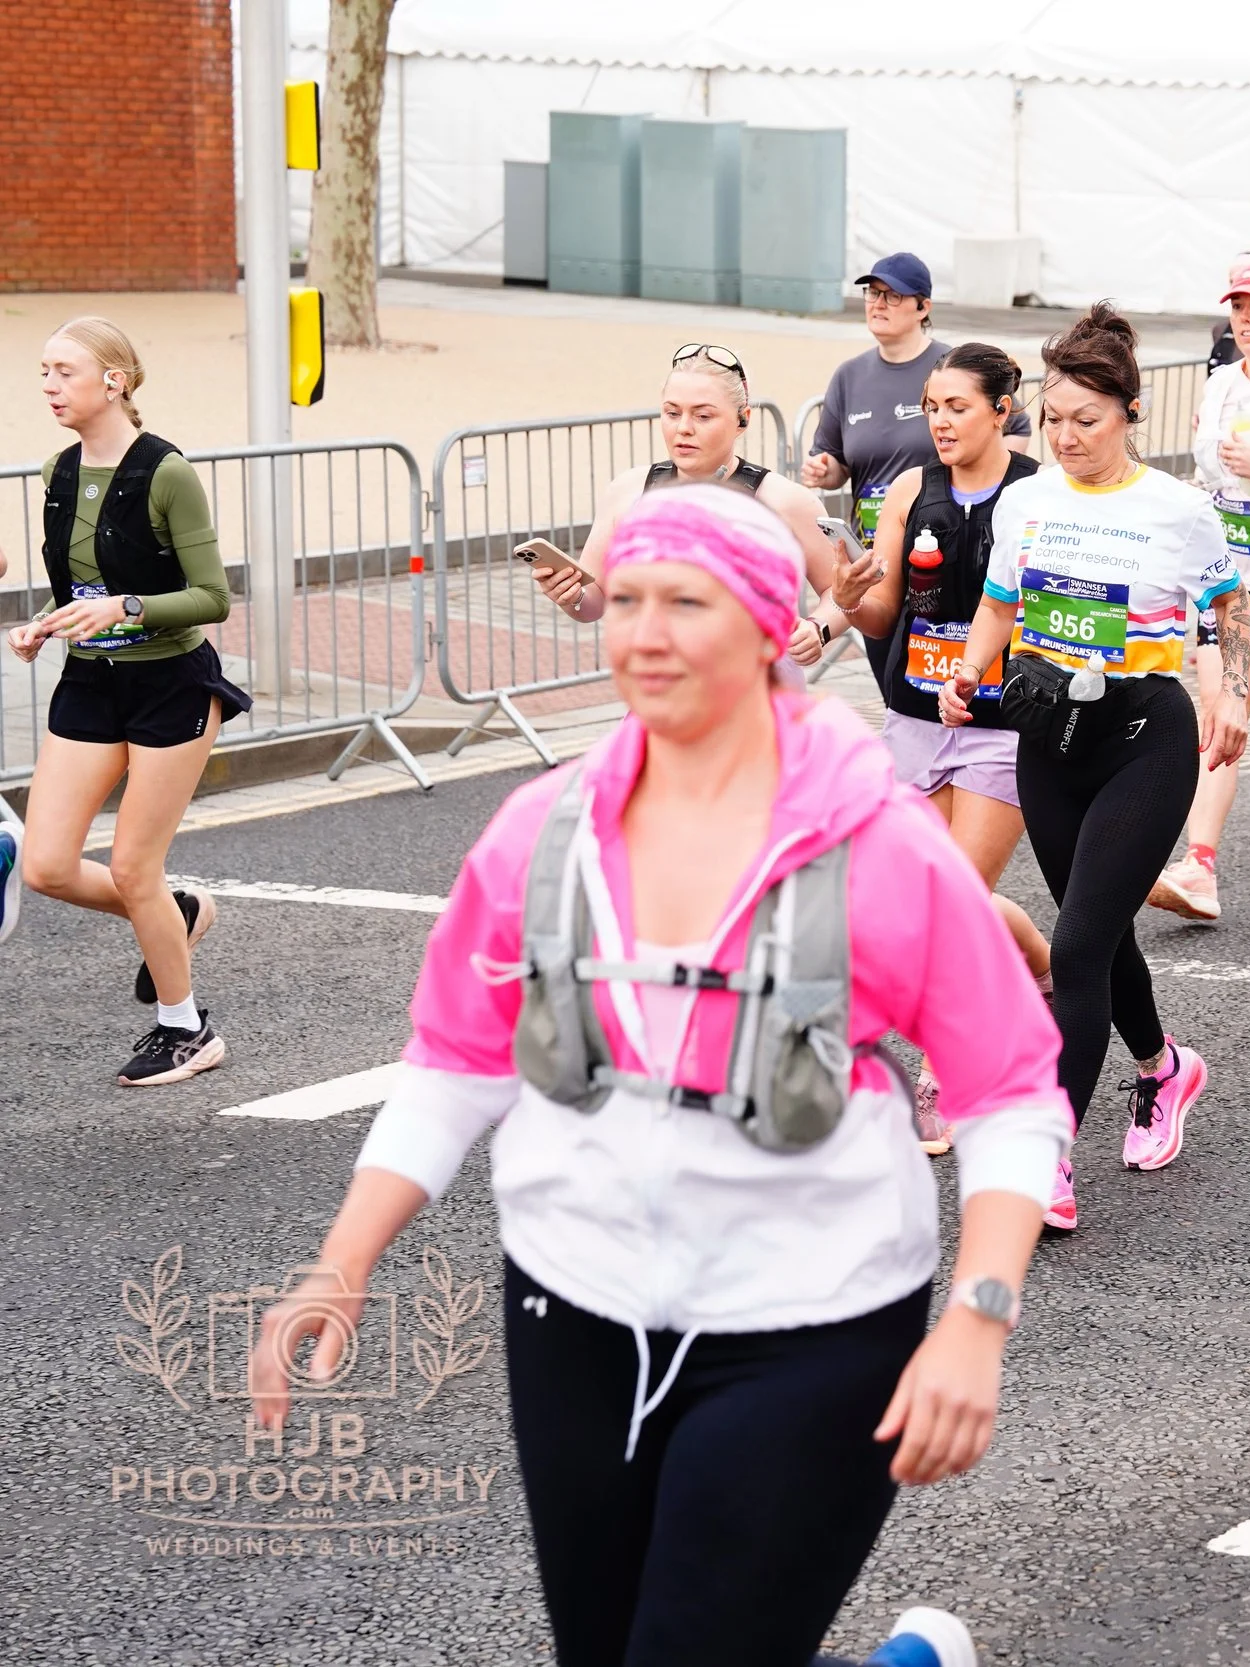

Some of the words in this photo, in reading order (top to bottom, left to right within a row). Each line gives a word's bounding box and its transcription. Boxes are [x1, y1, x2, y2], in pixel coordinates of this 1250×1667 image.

[1040, 534, 1081, 548] cymru
[1043, 520, 1100, 535] ymchwil
[1102, 526, 1152, 544] canser
[1035, 546, 1080, 559] cancer
[1080, 553, 1140, 572] research
[1070, 580, 1108, 592] SWANSEA
[1024, 592, 1039, 602] JO
[1049, 610, 1096, 640] 956
[909, 638, 940, 652] SARAH
[1060, 708, 1080, 754] WATERFLY
